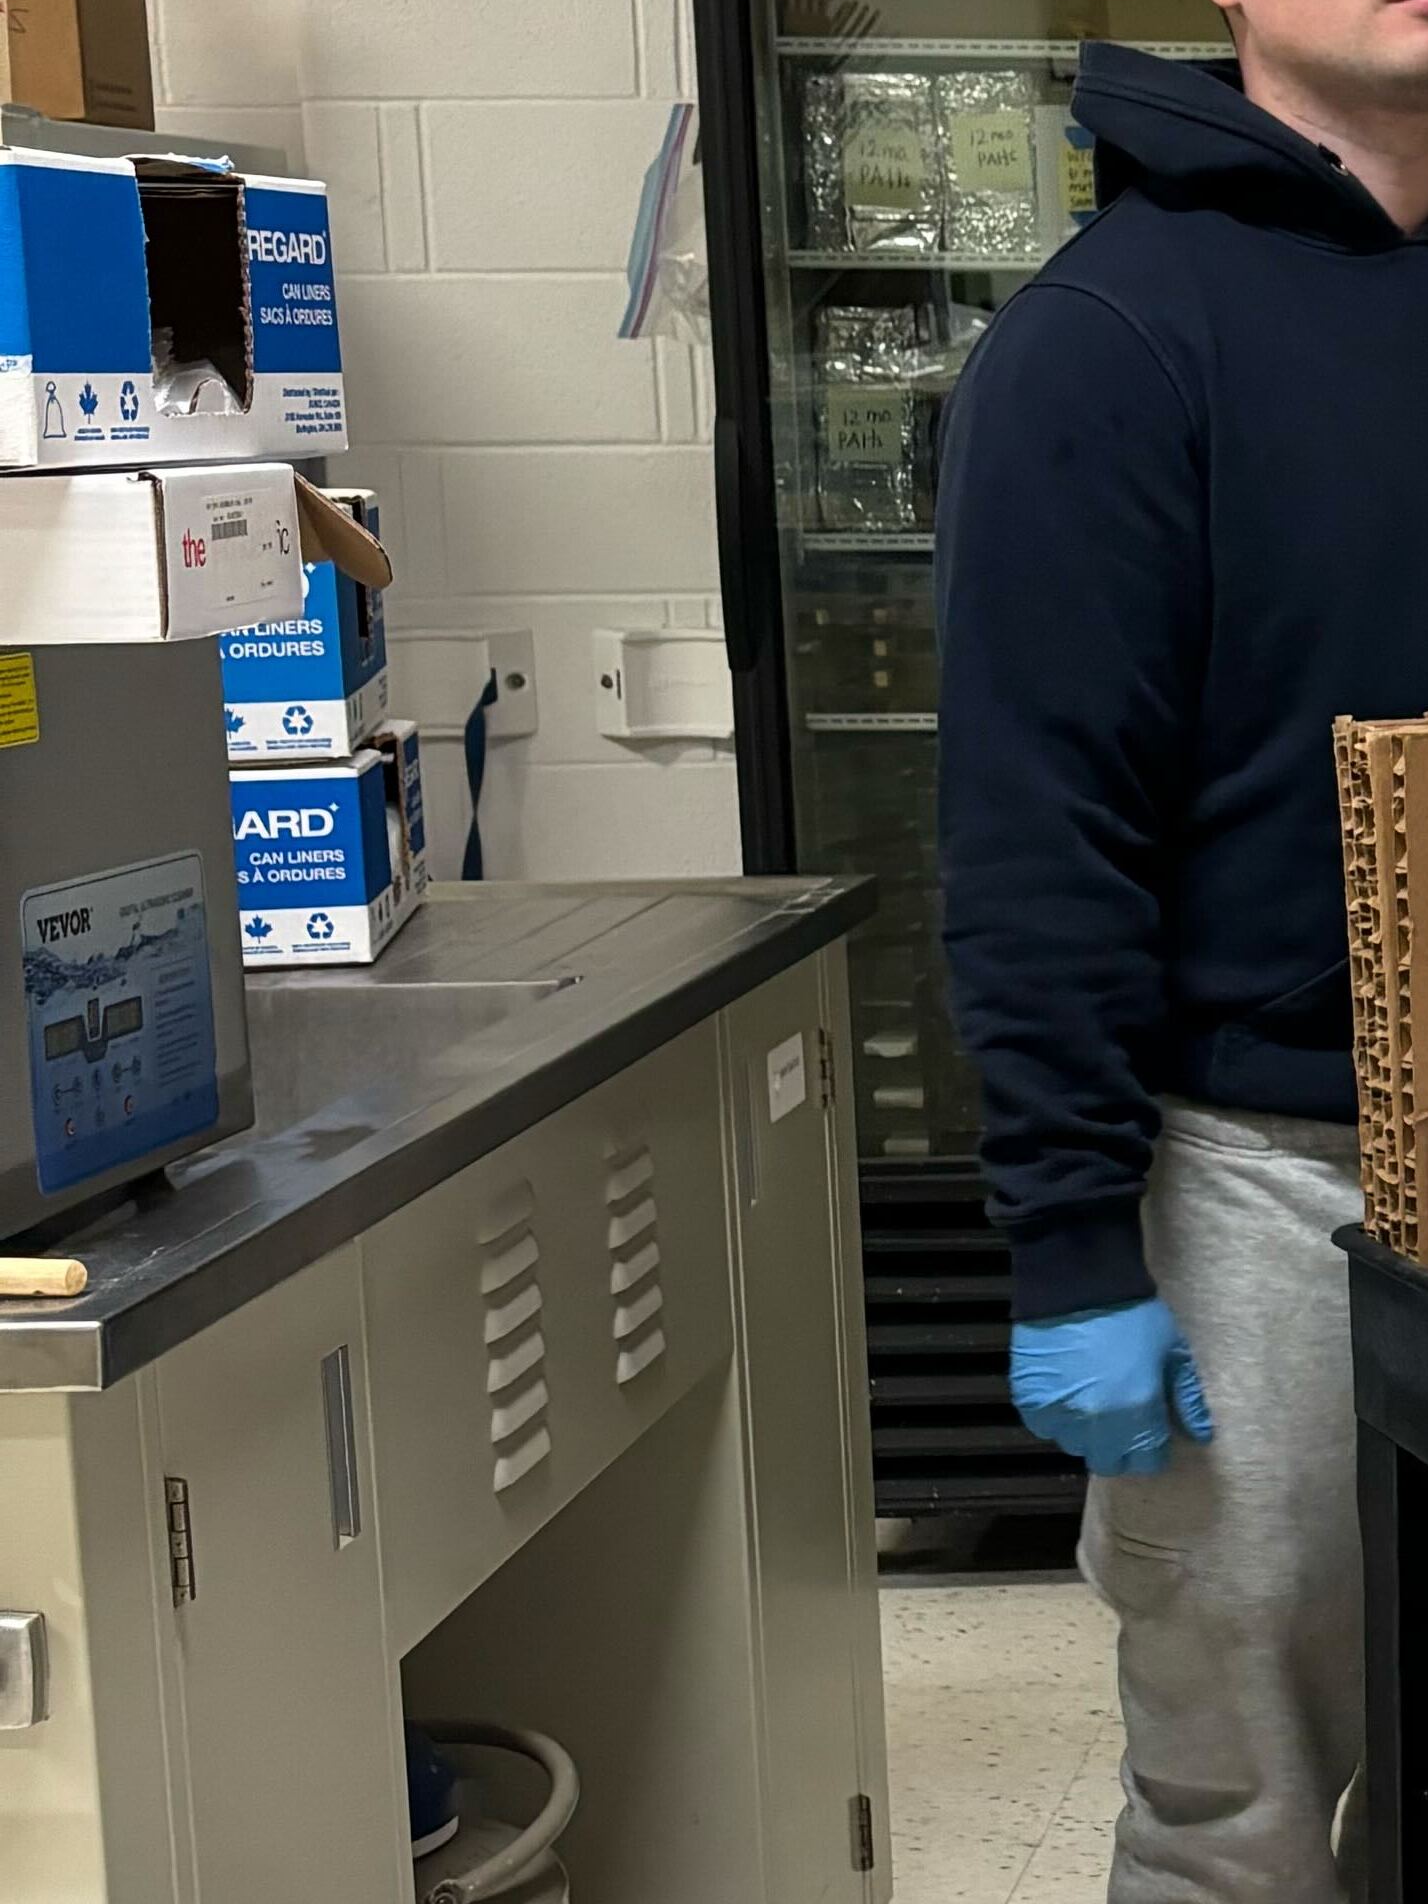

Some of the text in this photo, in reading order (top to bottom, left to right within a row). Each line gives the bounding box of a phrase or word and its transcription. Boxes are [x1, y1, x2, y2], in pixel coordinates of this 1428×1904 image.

[282, 282, 301, 300] CAN
[260, 306, 284, 326] SACS
[253, 618, 324, 636] LINERS
[229, 640, 325, 660] ORDURES
[233, 808, 335, 841] ARD
[249, 848, 346, 867] CAN LINERS
[252, 866, 265, 884] À
[266, 866, 347, 883] ORDURES
[37, 907, 92, 945] VEVOR
